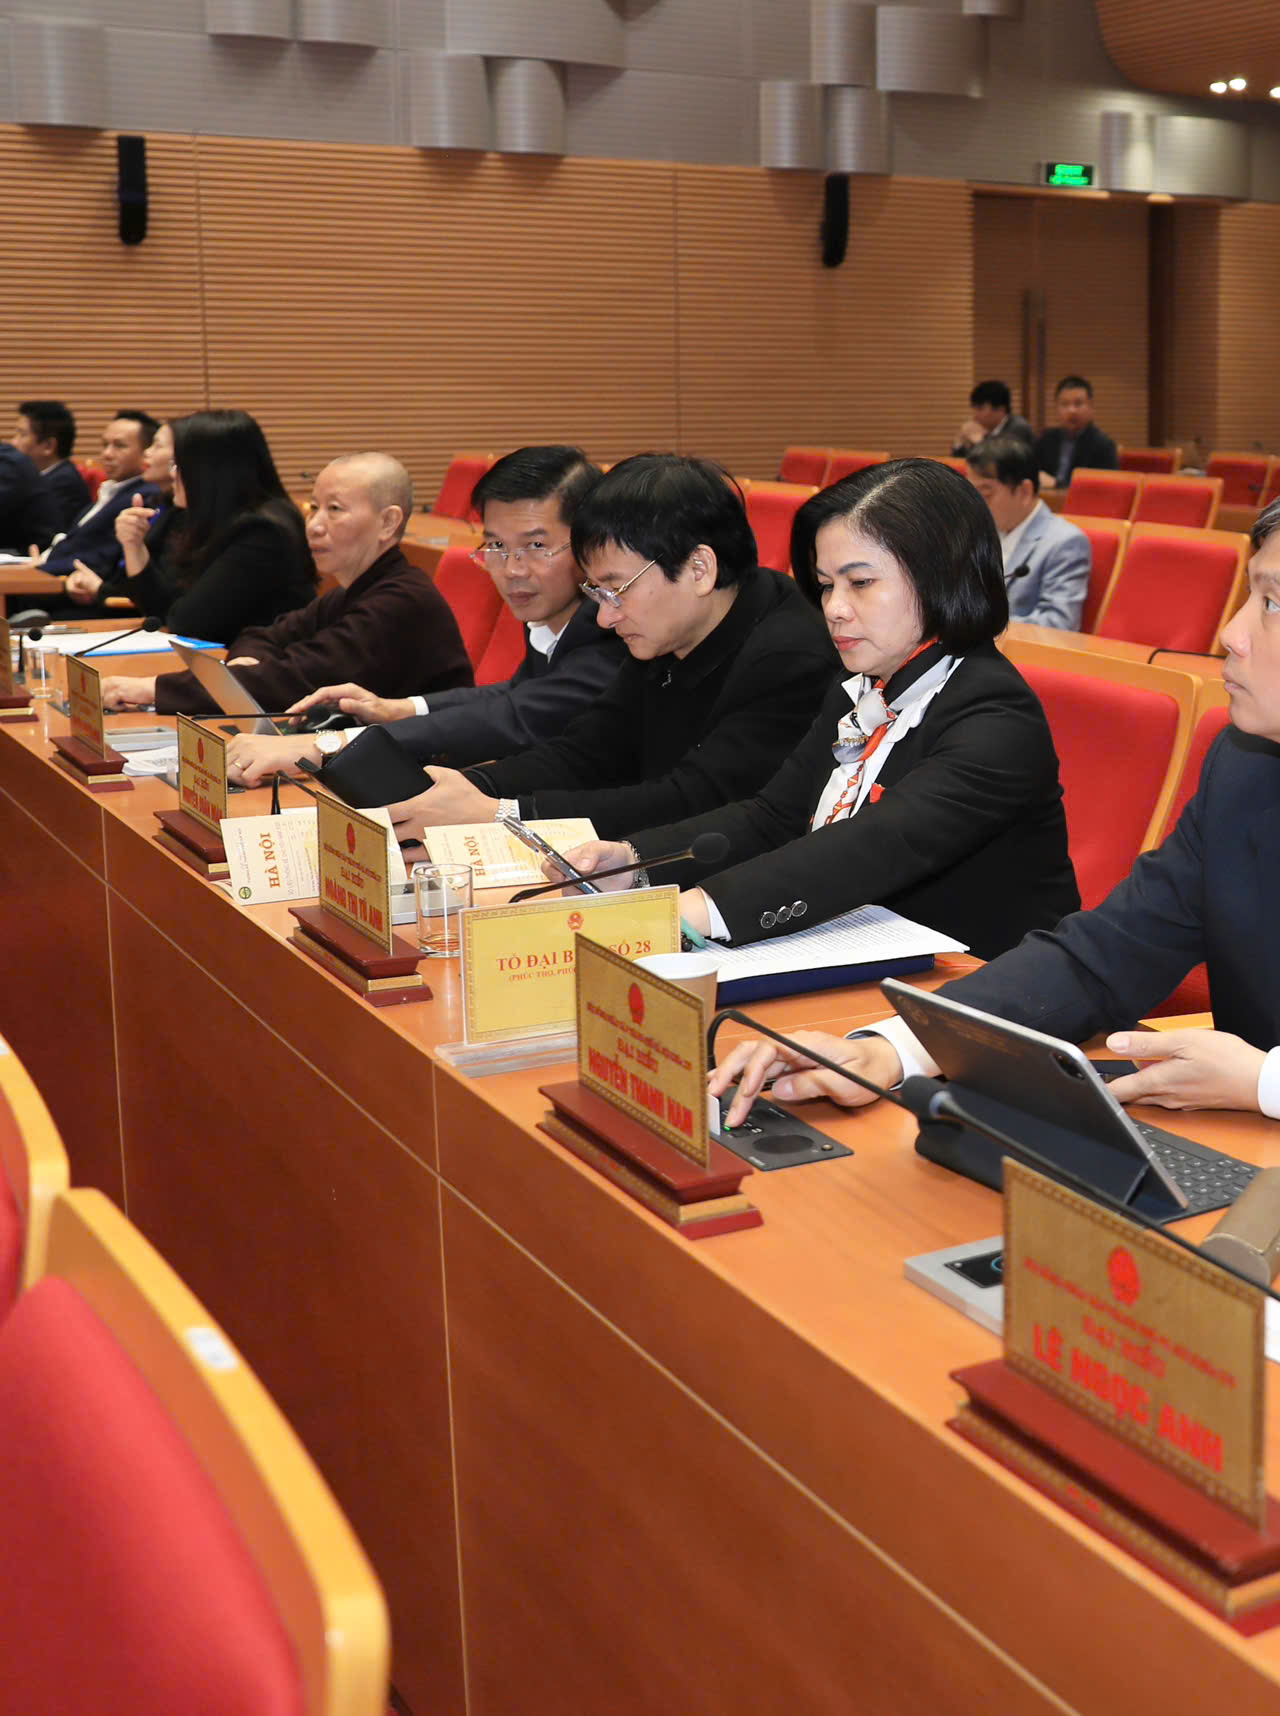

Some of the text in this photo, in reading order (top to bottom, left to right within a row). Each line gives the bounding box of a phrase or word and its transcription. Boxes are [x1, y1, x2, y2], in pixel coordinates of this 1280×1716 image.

[259, 832, 280, 888] HÀ NỘI
[464, 835, 480, 857] NỘI
[527, 951, 558, 969] ĐẠI
[635, 940, 651, 954] 28
[1033, 1324, 1063, 1373] LÊ
[1158, 1403, 1224, 1473] ANH
